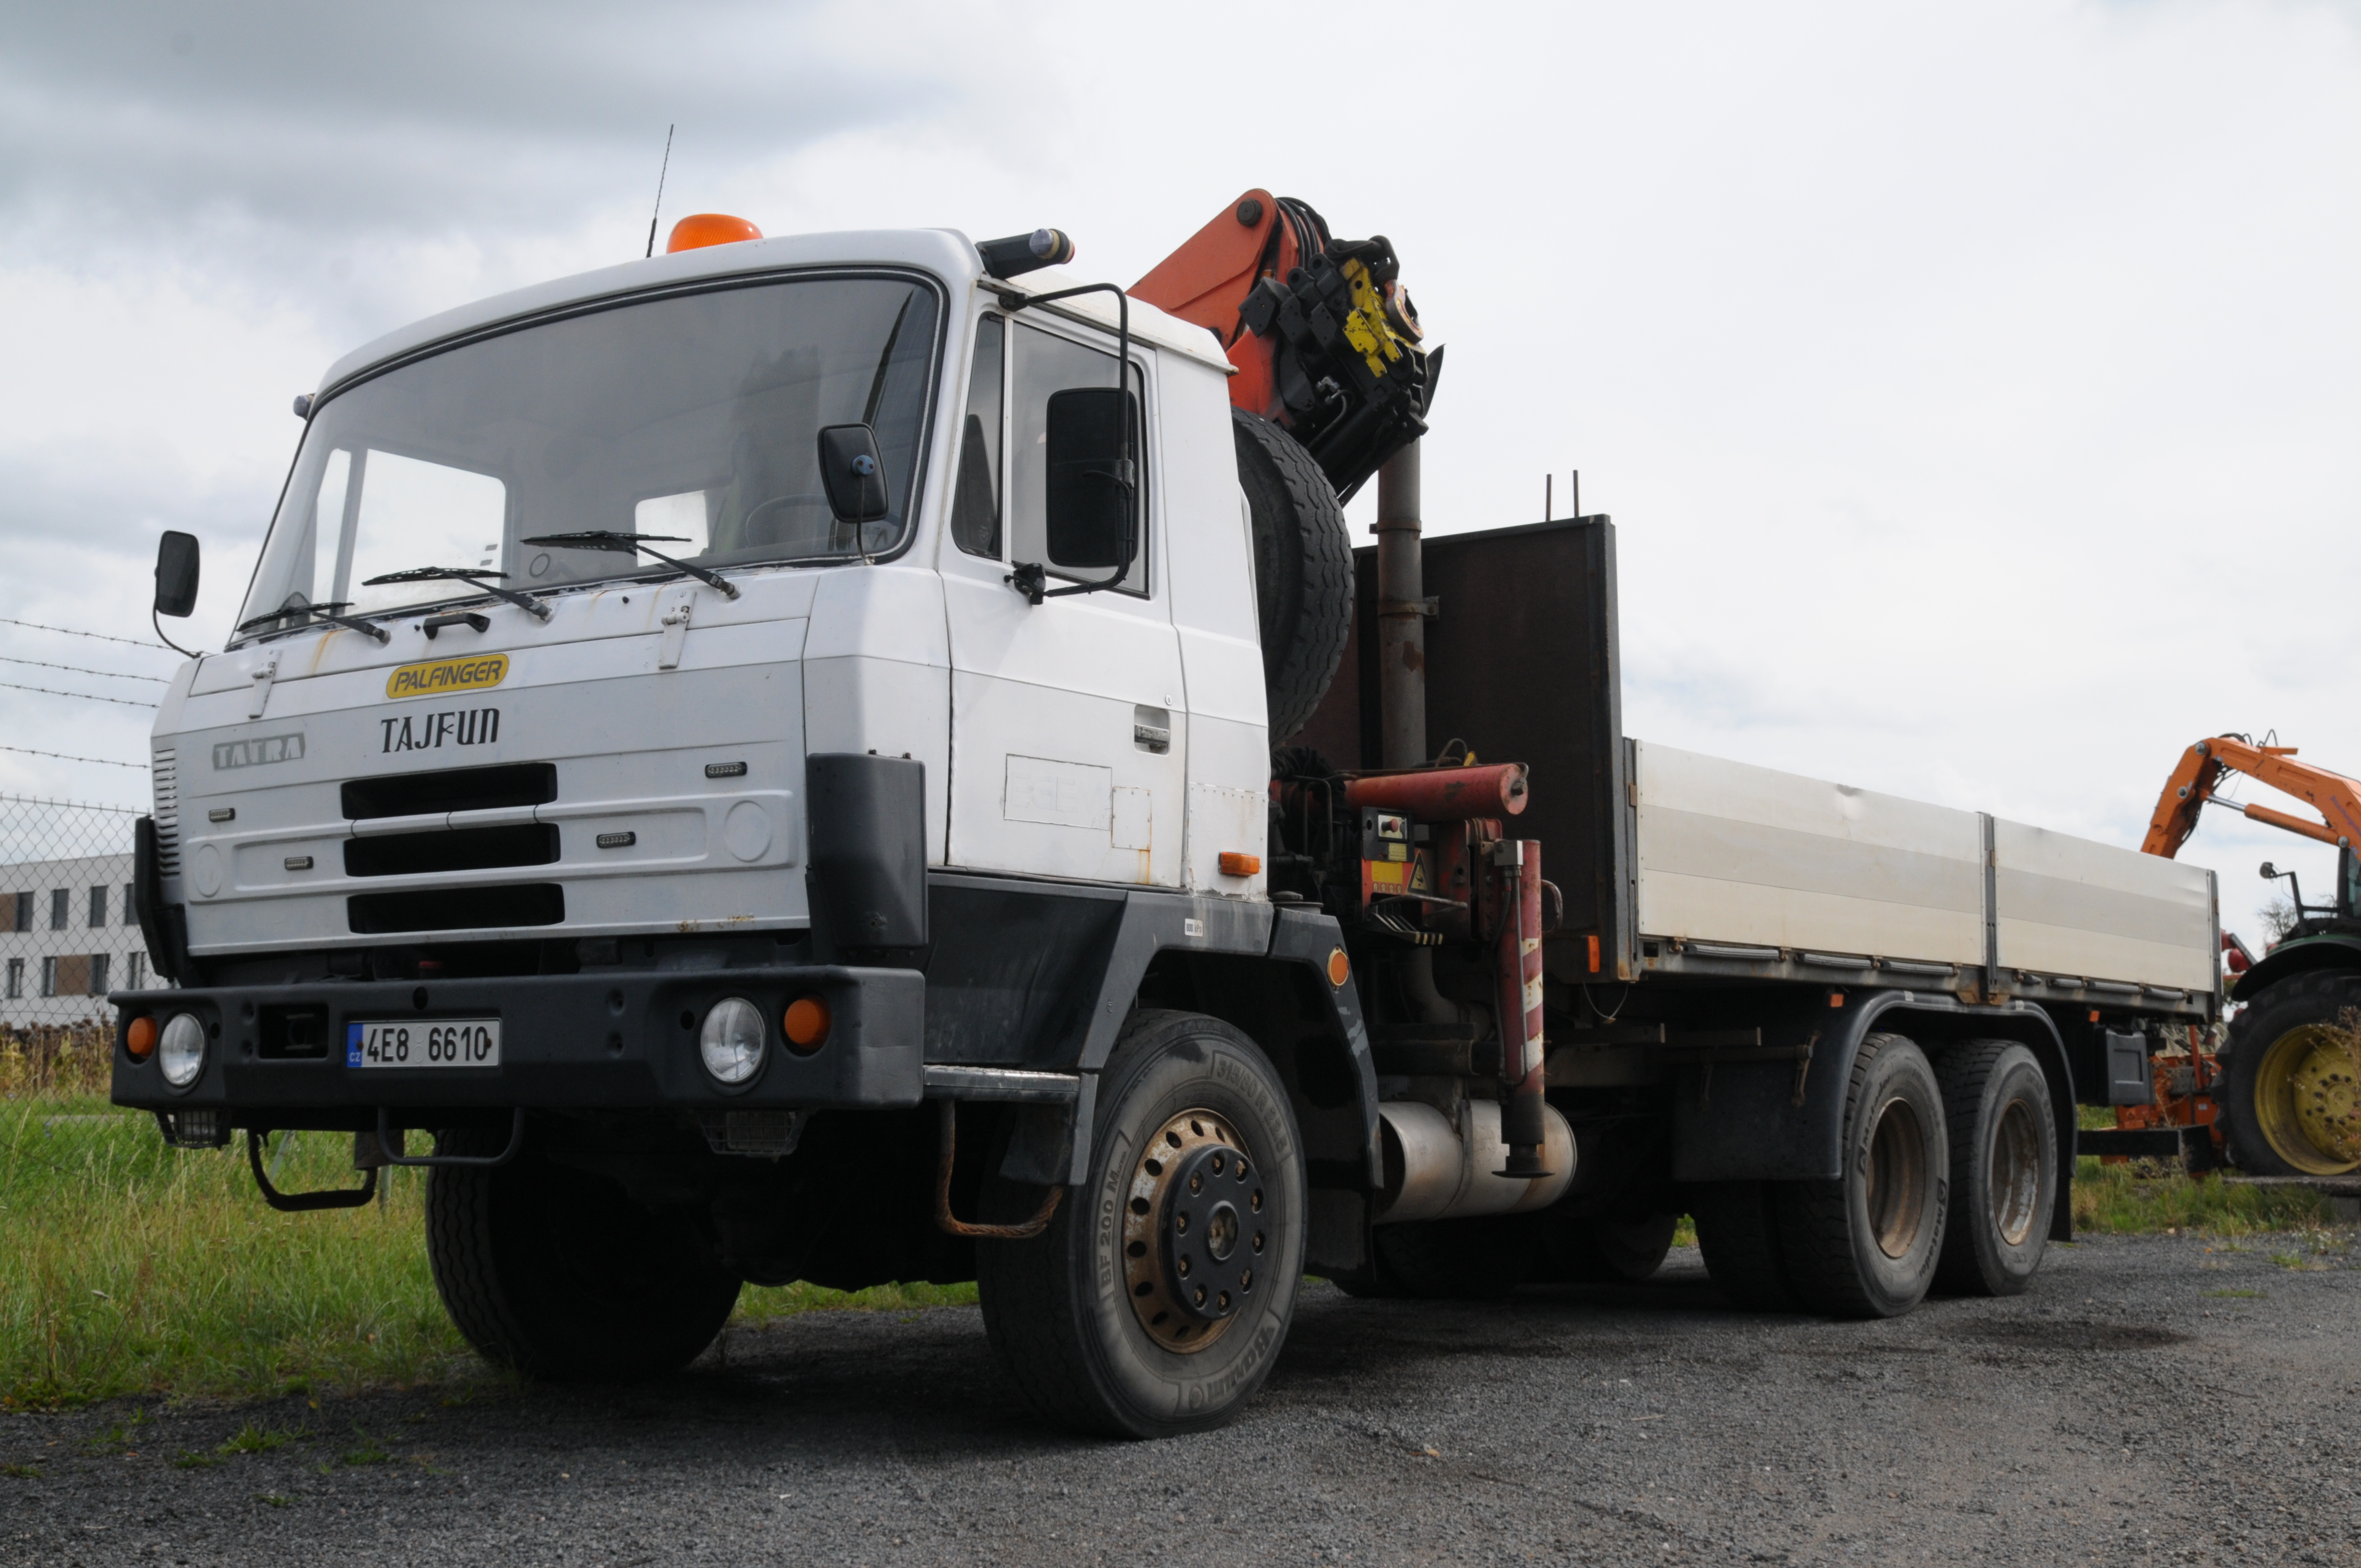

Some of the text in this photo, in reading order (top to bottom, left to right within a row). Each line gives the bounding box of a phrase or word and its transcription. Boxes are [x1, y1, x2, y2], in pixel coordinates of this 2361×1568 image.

[393, 660, 502, 693] PALFINGER
[381, 708, 500, 754] TAJFUN
[214, 736, 303, 768] TATRA
[349, 1052, 361, 1063] CZ
[367, 1026, 488, 1062] 4E8 6610
[1217, 1060, 1259, 1098] 315/80
[1255, 1090, 1268, 1113] R
[1100, 1199, 1114, 1246] 200
[1100, 1255, 1112, 1288] BF
